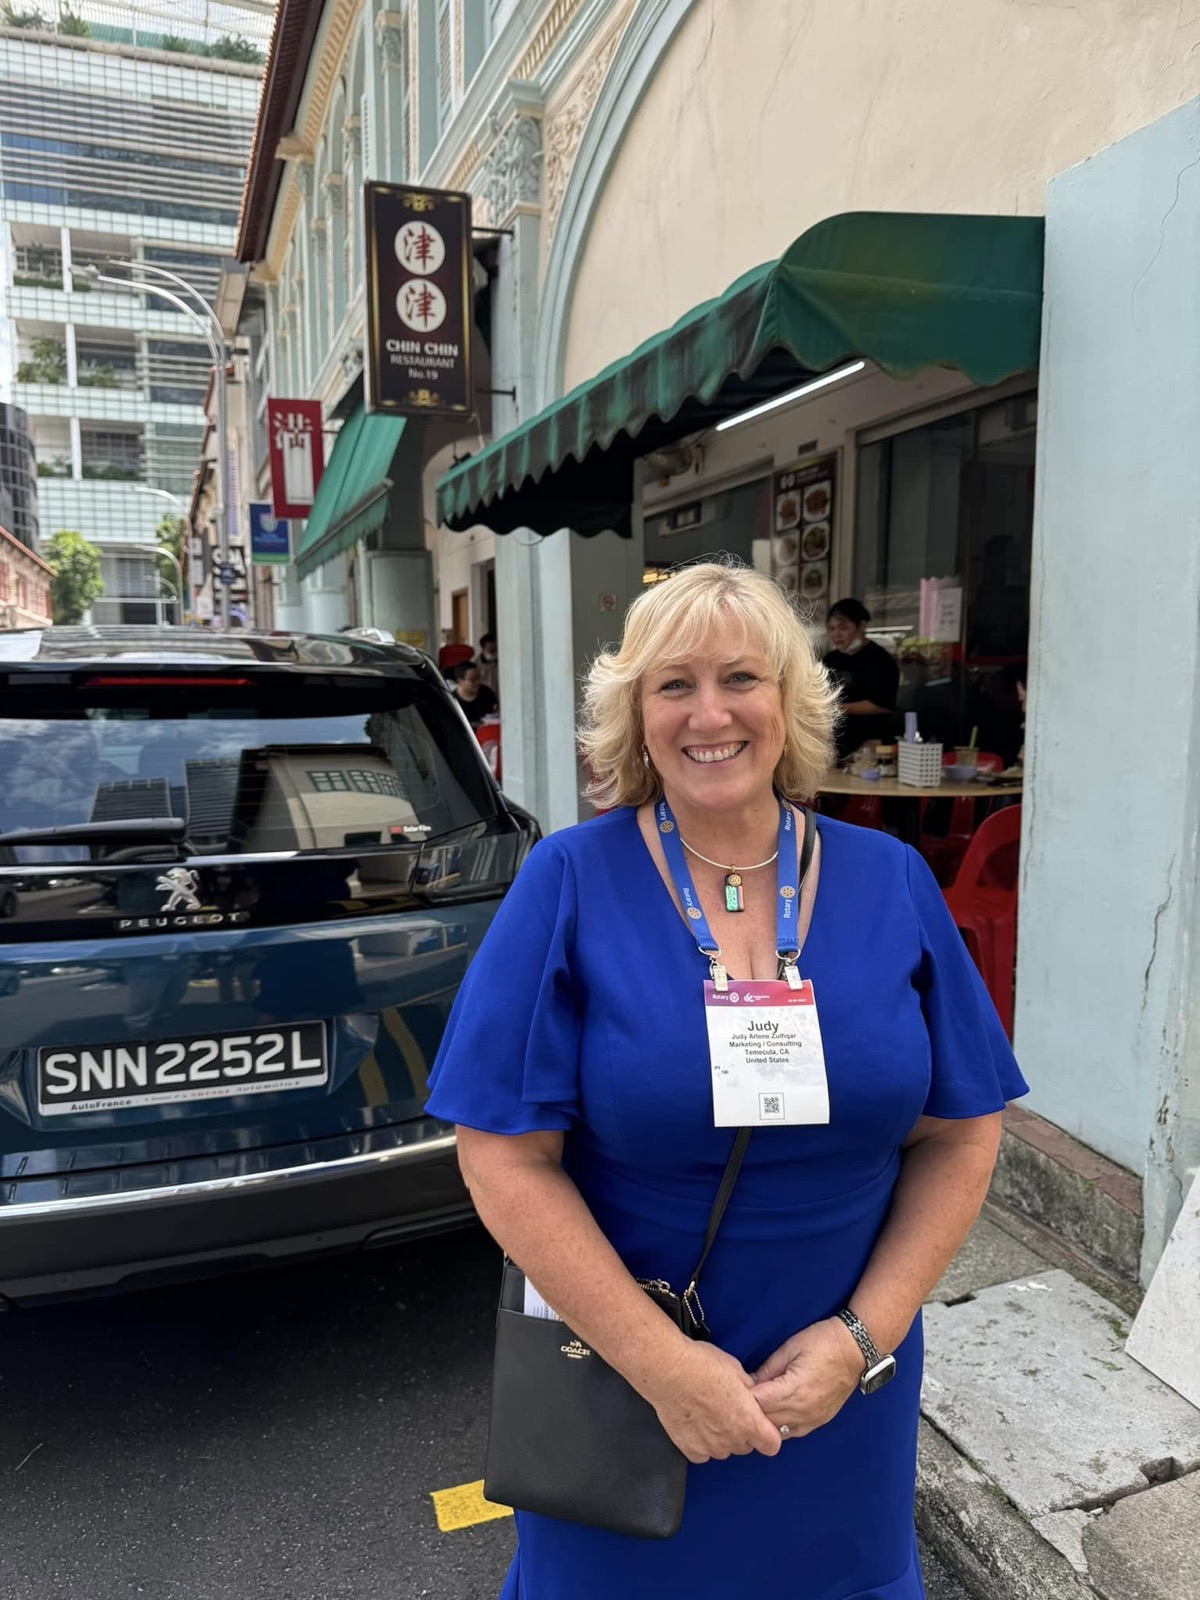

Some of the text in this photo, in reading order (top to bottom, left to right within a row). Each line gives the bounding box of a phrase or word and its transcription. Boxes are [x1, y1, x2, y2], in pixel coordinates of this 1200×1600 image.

[385, 339, 459, 357] CHIN CHIN
[390, 354, 454, 369] RESTAURANT
[408, 367, 438, 380] No.19
[784, 811, 792, 831] Rotary
[682, 887, 693, 907] Rotary
[783, 898, 792, 919] Rotary
[119, 912, 241, 929] PEUGEOT
[747, 1020, 779, 1034] Judy
[729, 1041, 762, 1049] Marketing
[766, 1040, 802, 1048] Consulting
[71, 1099, 132, 1111] AutoFrance
